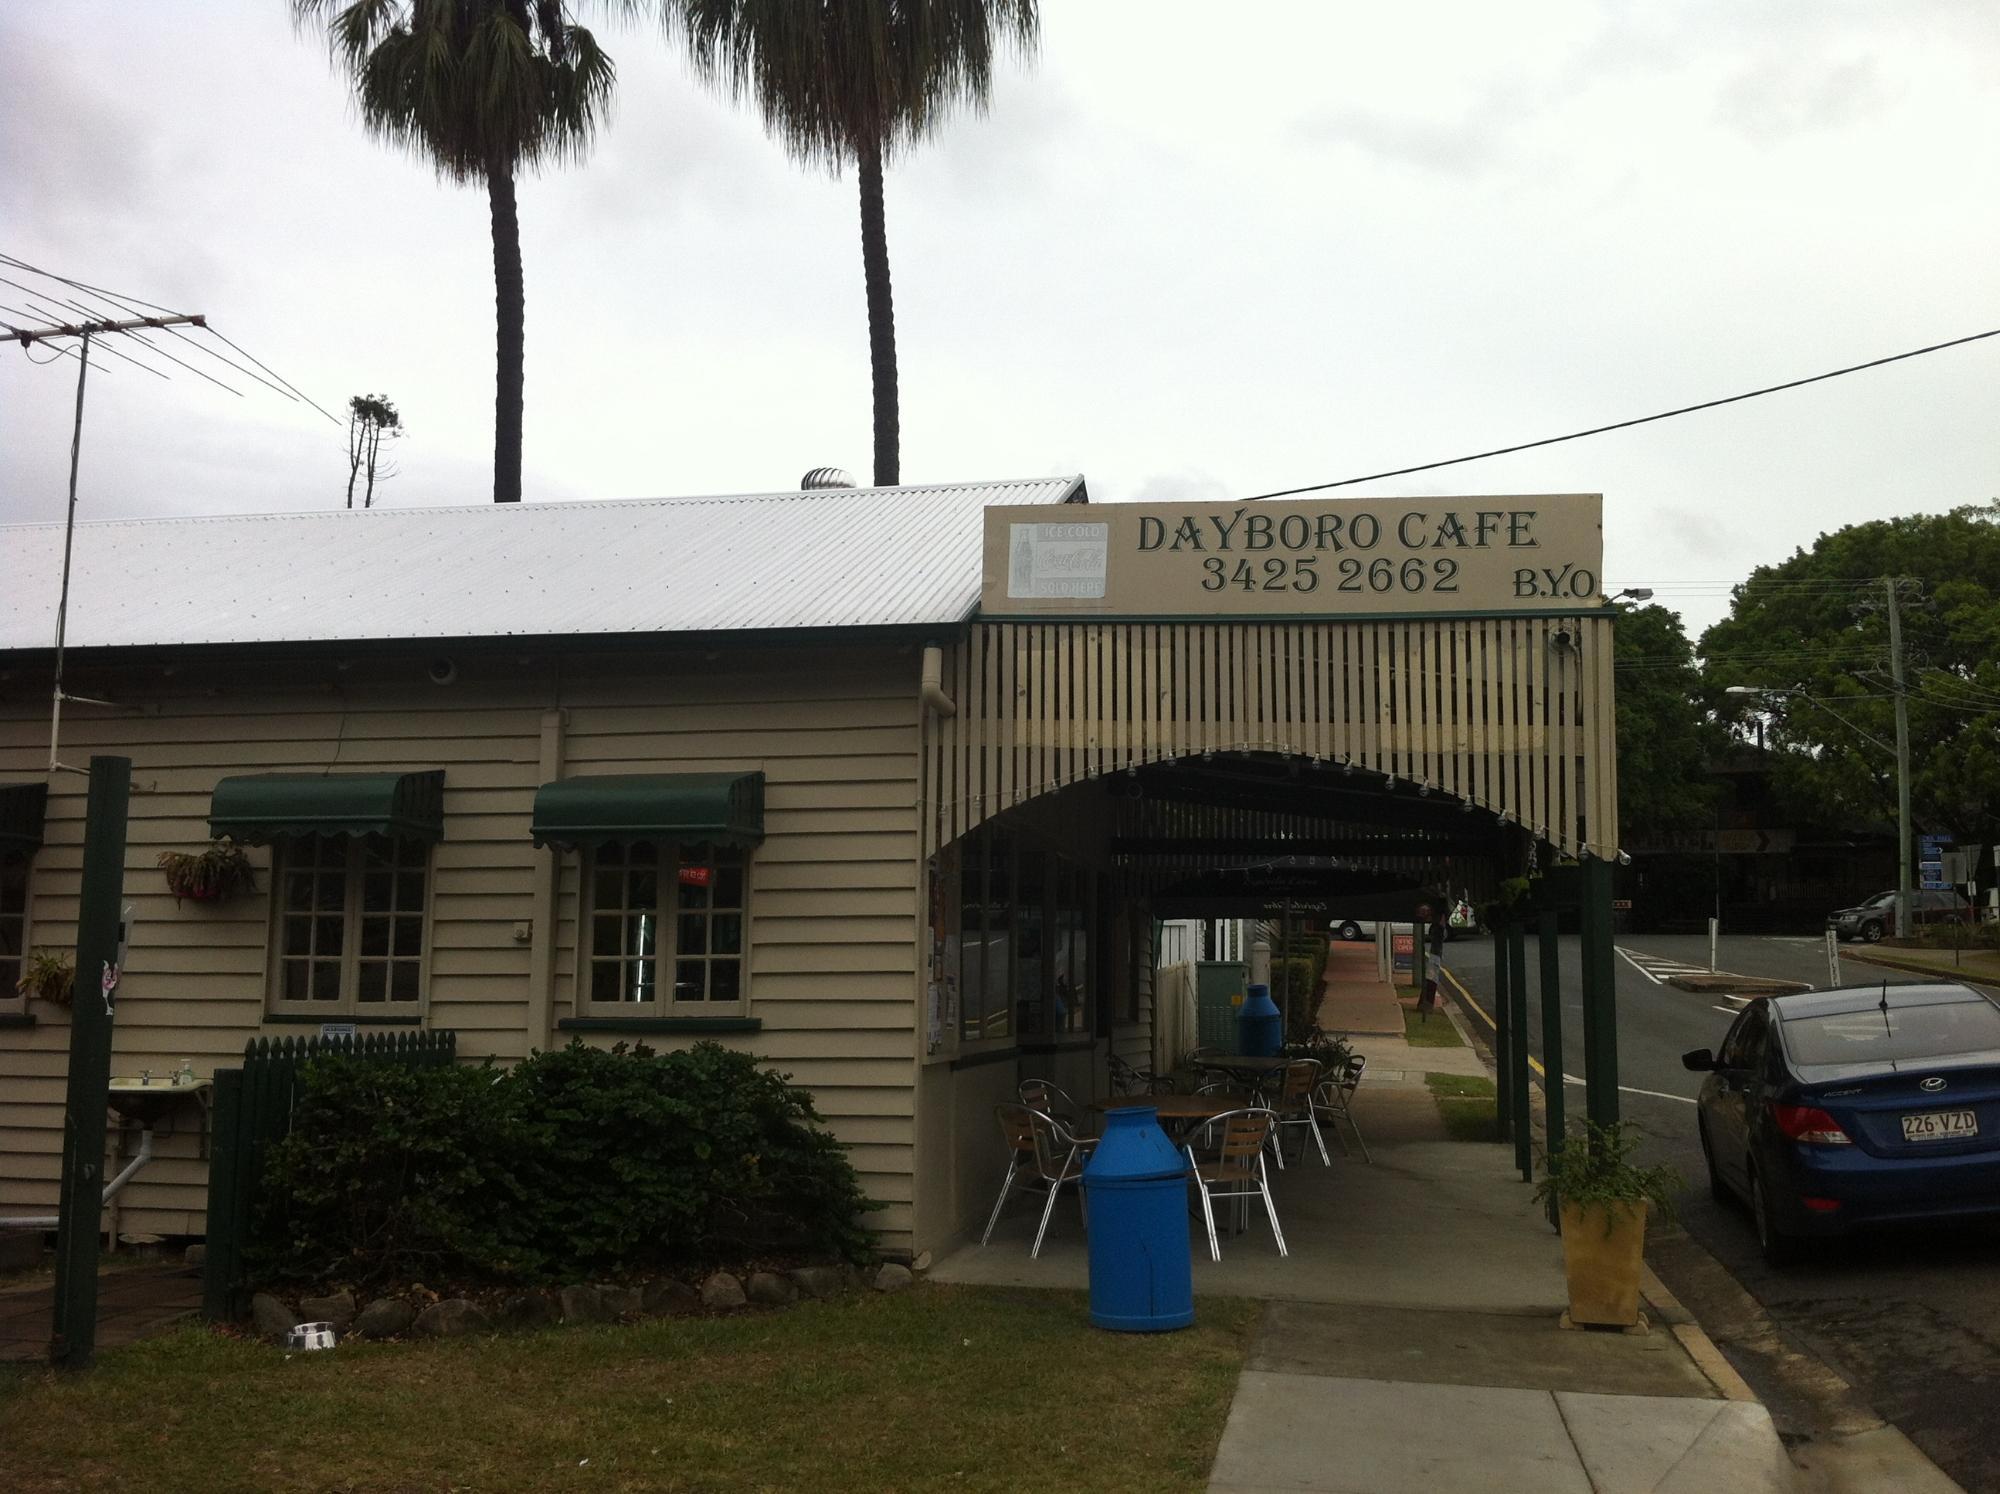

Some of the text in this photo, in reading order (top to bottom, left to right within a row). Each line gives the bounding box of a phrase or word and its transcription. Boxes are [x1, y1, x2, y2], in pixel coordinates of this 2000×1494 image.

[1044, 526, 1100, 538] ICE COLD
[1137, 507, 1542, 552] DAYBORO CAFE
[1201, 555, 1460, 593] 3425 2662
[1040, 581, 1069, 594] SOLD
[1904, 1116, 1935, 1134] 226
[1939, 1112, 1975, 1131] VZD
